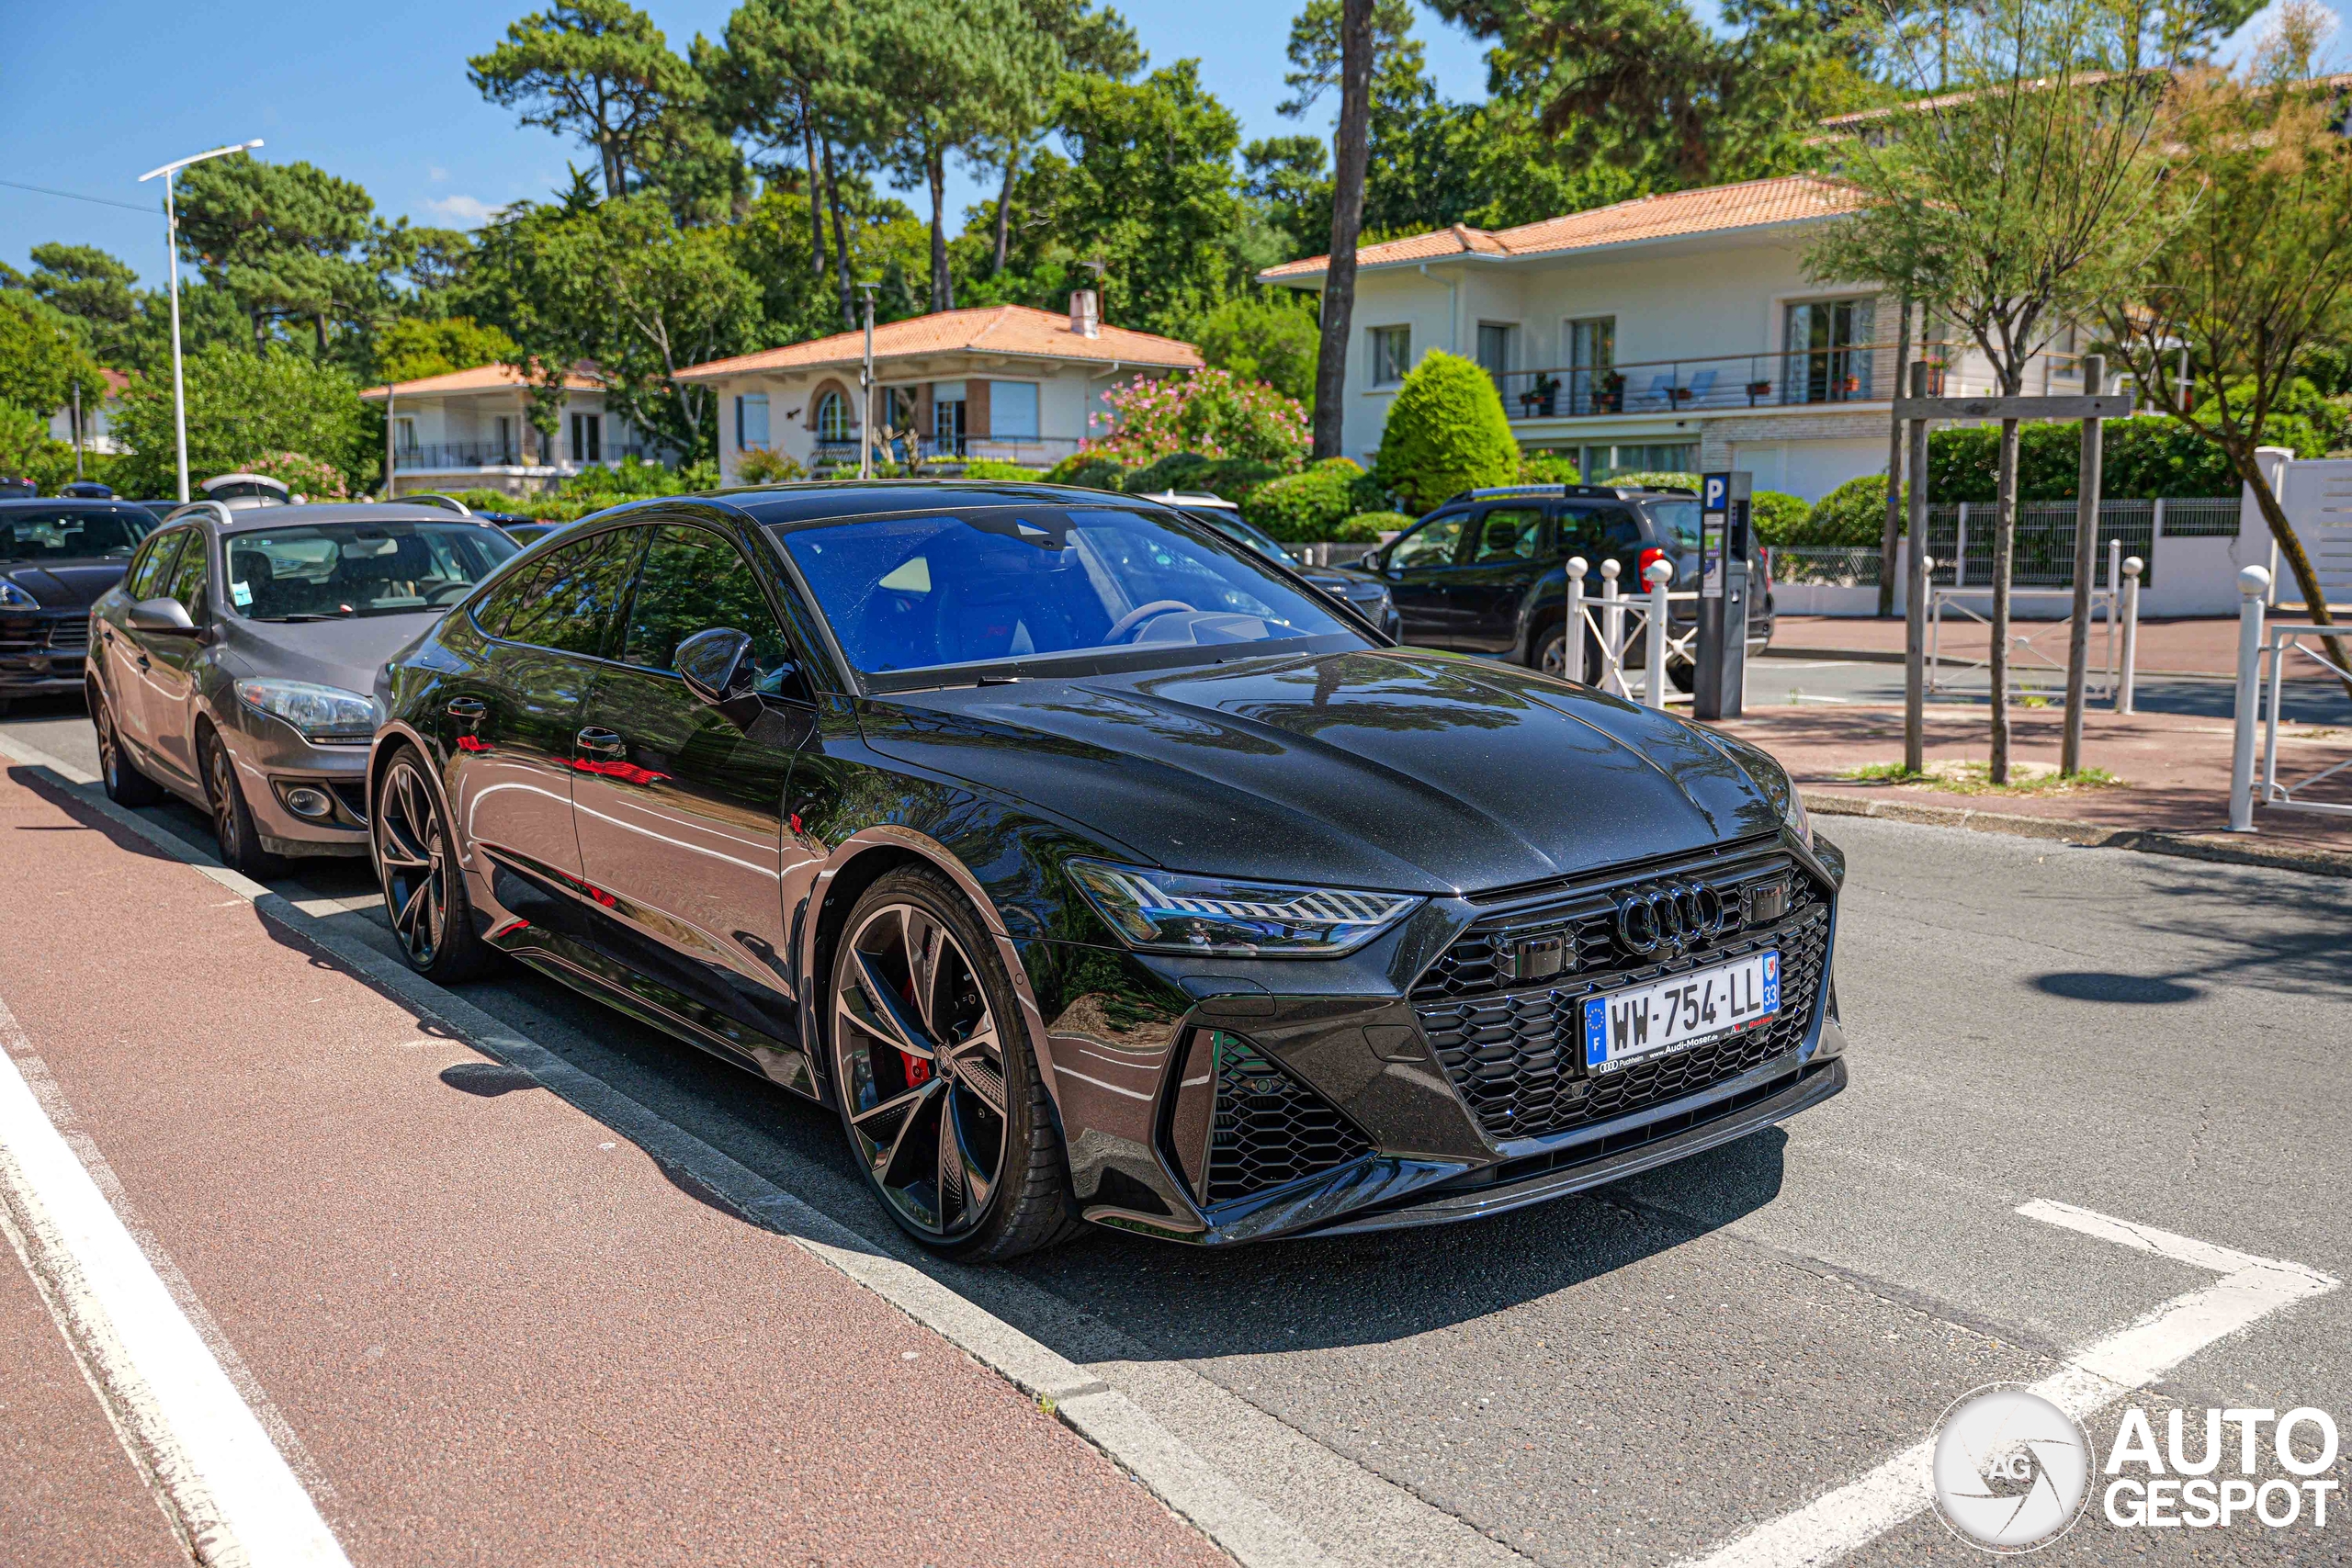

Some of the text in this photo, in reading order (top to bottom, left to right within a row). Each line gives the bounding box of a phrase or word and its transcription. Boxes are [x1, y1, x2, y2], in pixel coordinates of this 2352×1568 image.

[1707, 479, 1724, 507] P
[1764, 984, 1777, 1006] 33
[1611, 968, 1760, 1051] WW-754-LL
[1593, 1037, 1600, 1051] F
[1619, 1034, 1718, 1067] Puchheim www.Audi-Moser.de
